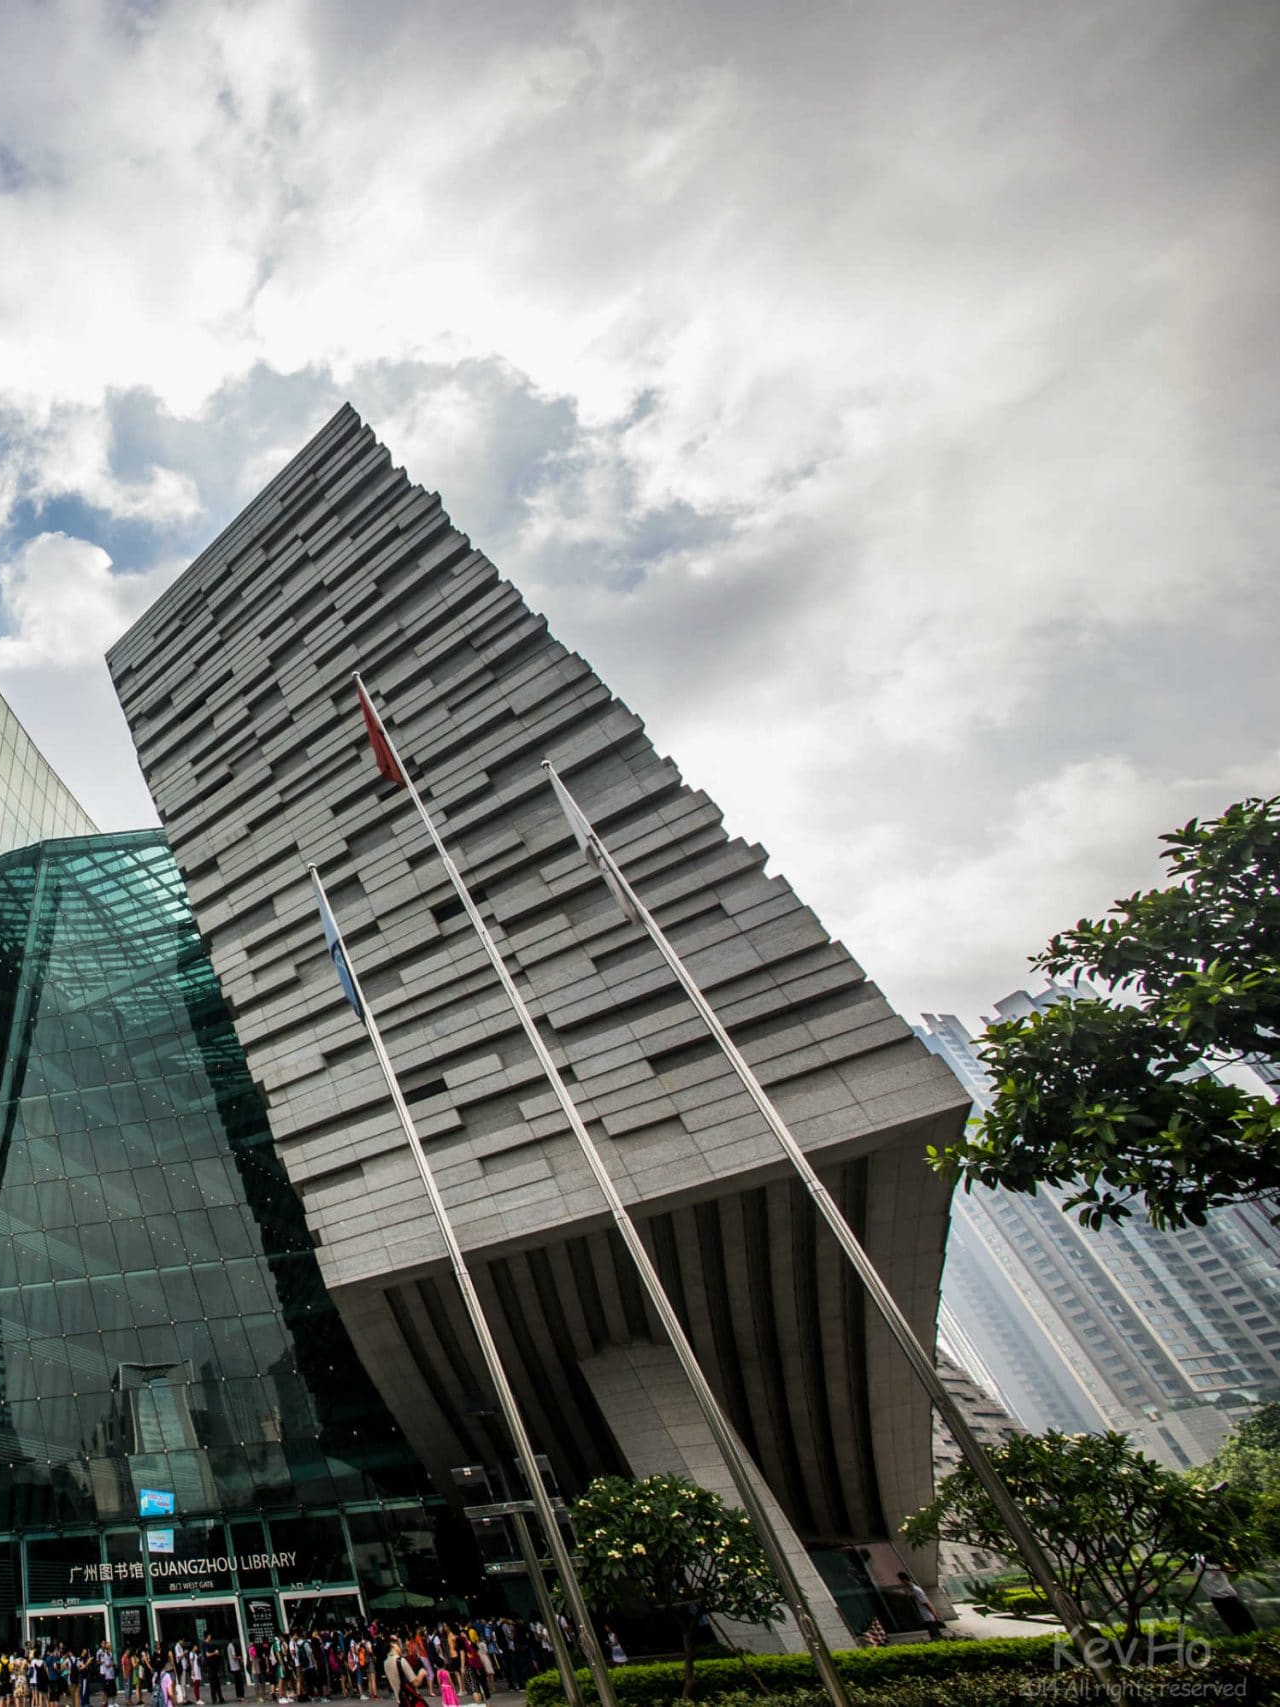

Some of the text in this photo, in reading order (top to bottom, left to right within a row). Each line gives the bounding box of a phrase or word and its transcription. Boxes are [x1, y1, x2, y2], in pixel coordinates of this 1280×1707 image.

[69, 1551, 297, 1584] 广州图书馆 GUANGZHOU LIBRARY
[183, 1581, 198, 1590] WEST
[199, 1580, 215, 1589] GATE
